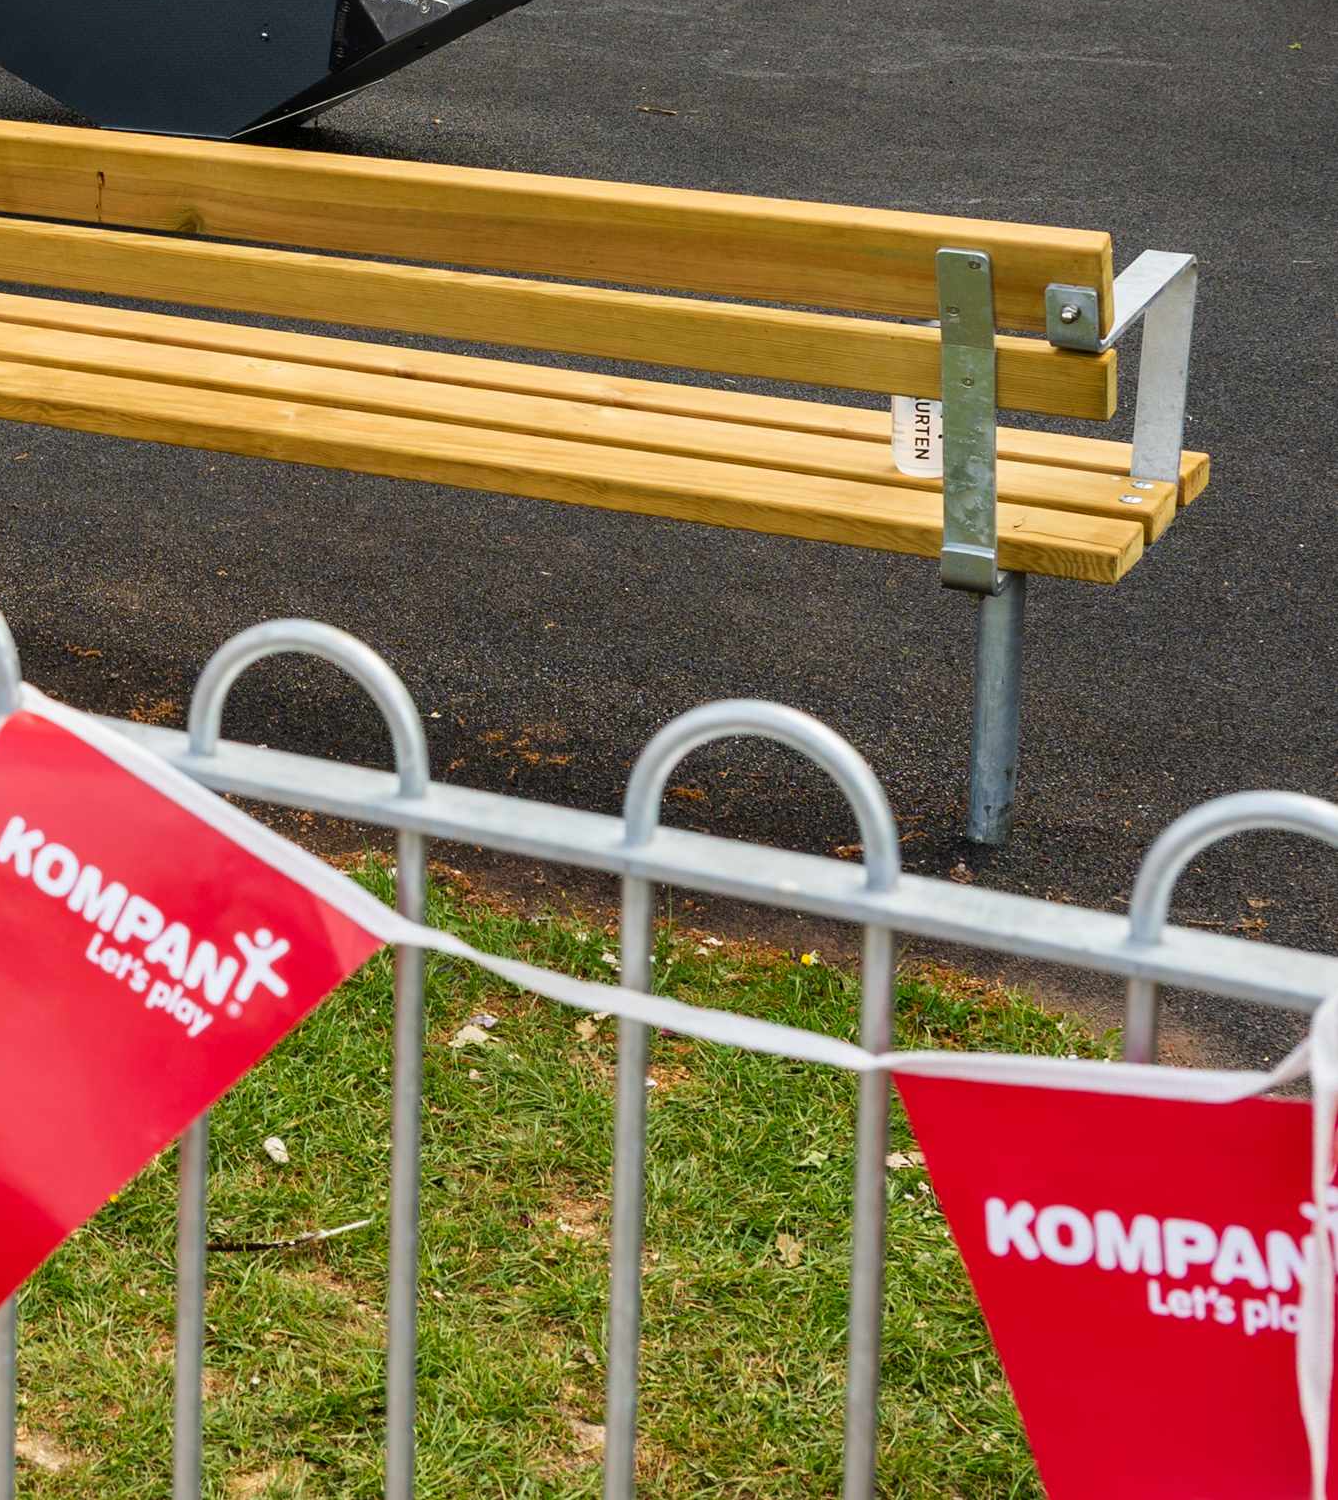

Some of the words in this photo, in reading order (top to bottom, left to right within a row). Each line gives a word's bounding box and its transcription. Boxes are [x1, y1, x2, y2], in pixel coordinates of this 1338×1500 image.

[914, 398, 931, 460] URTEN
[85, 932, 152, 993] Let's
[145, 976, 214, 1038] play
[1146, 1279, 1236, 1325] Let's
